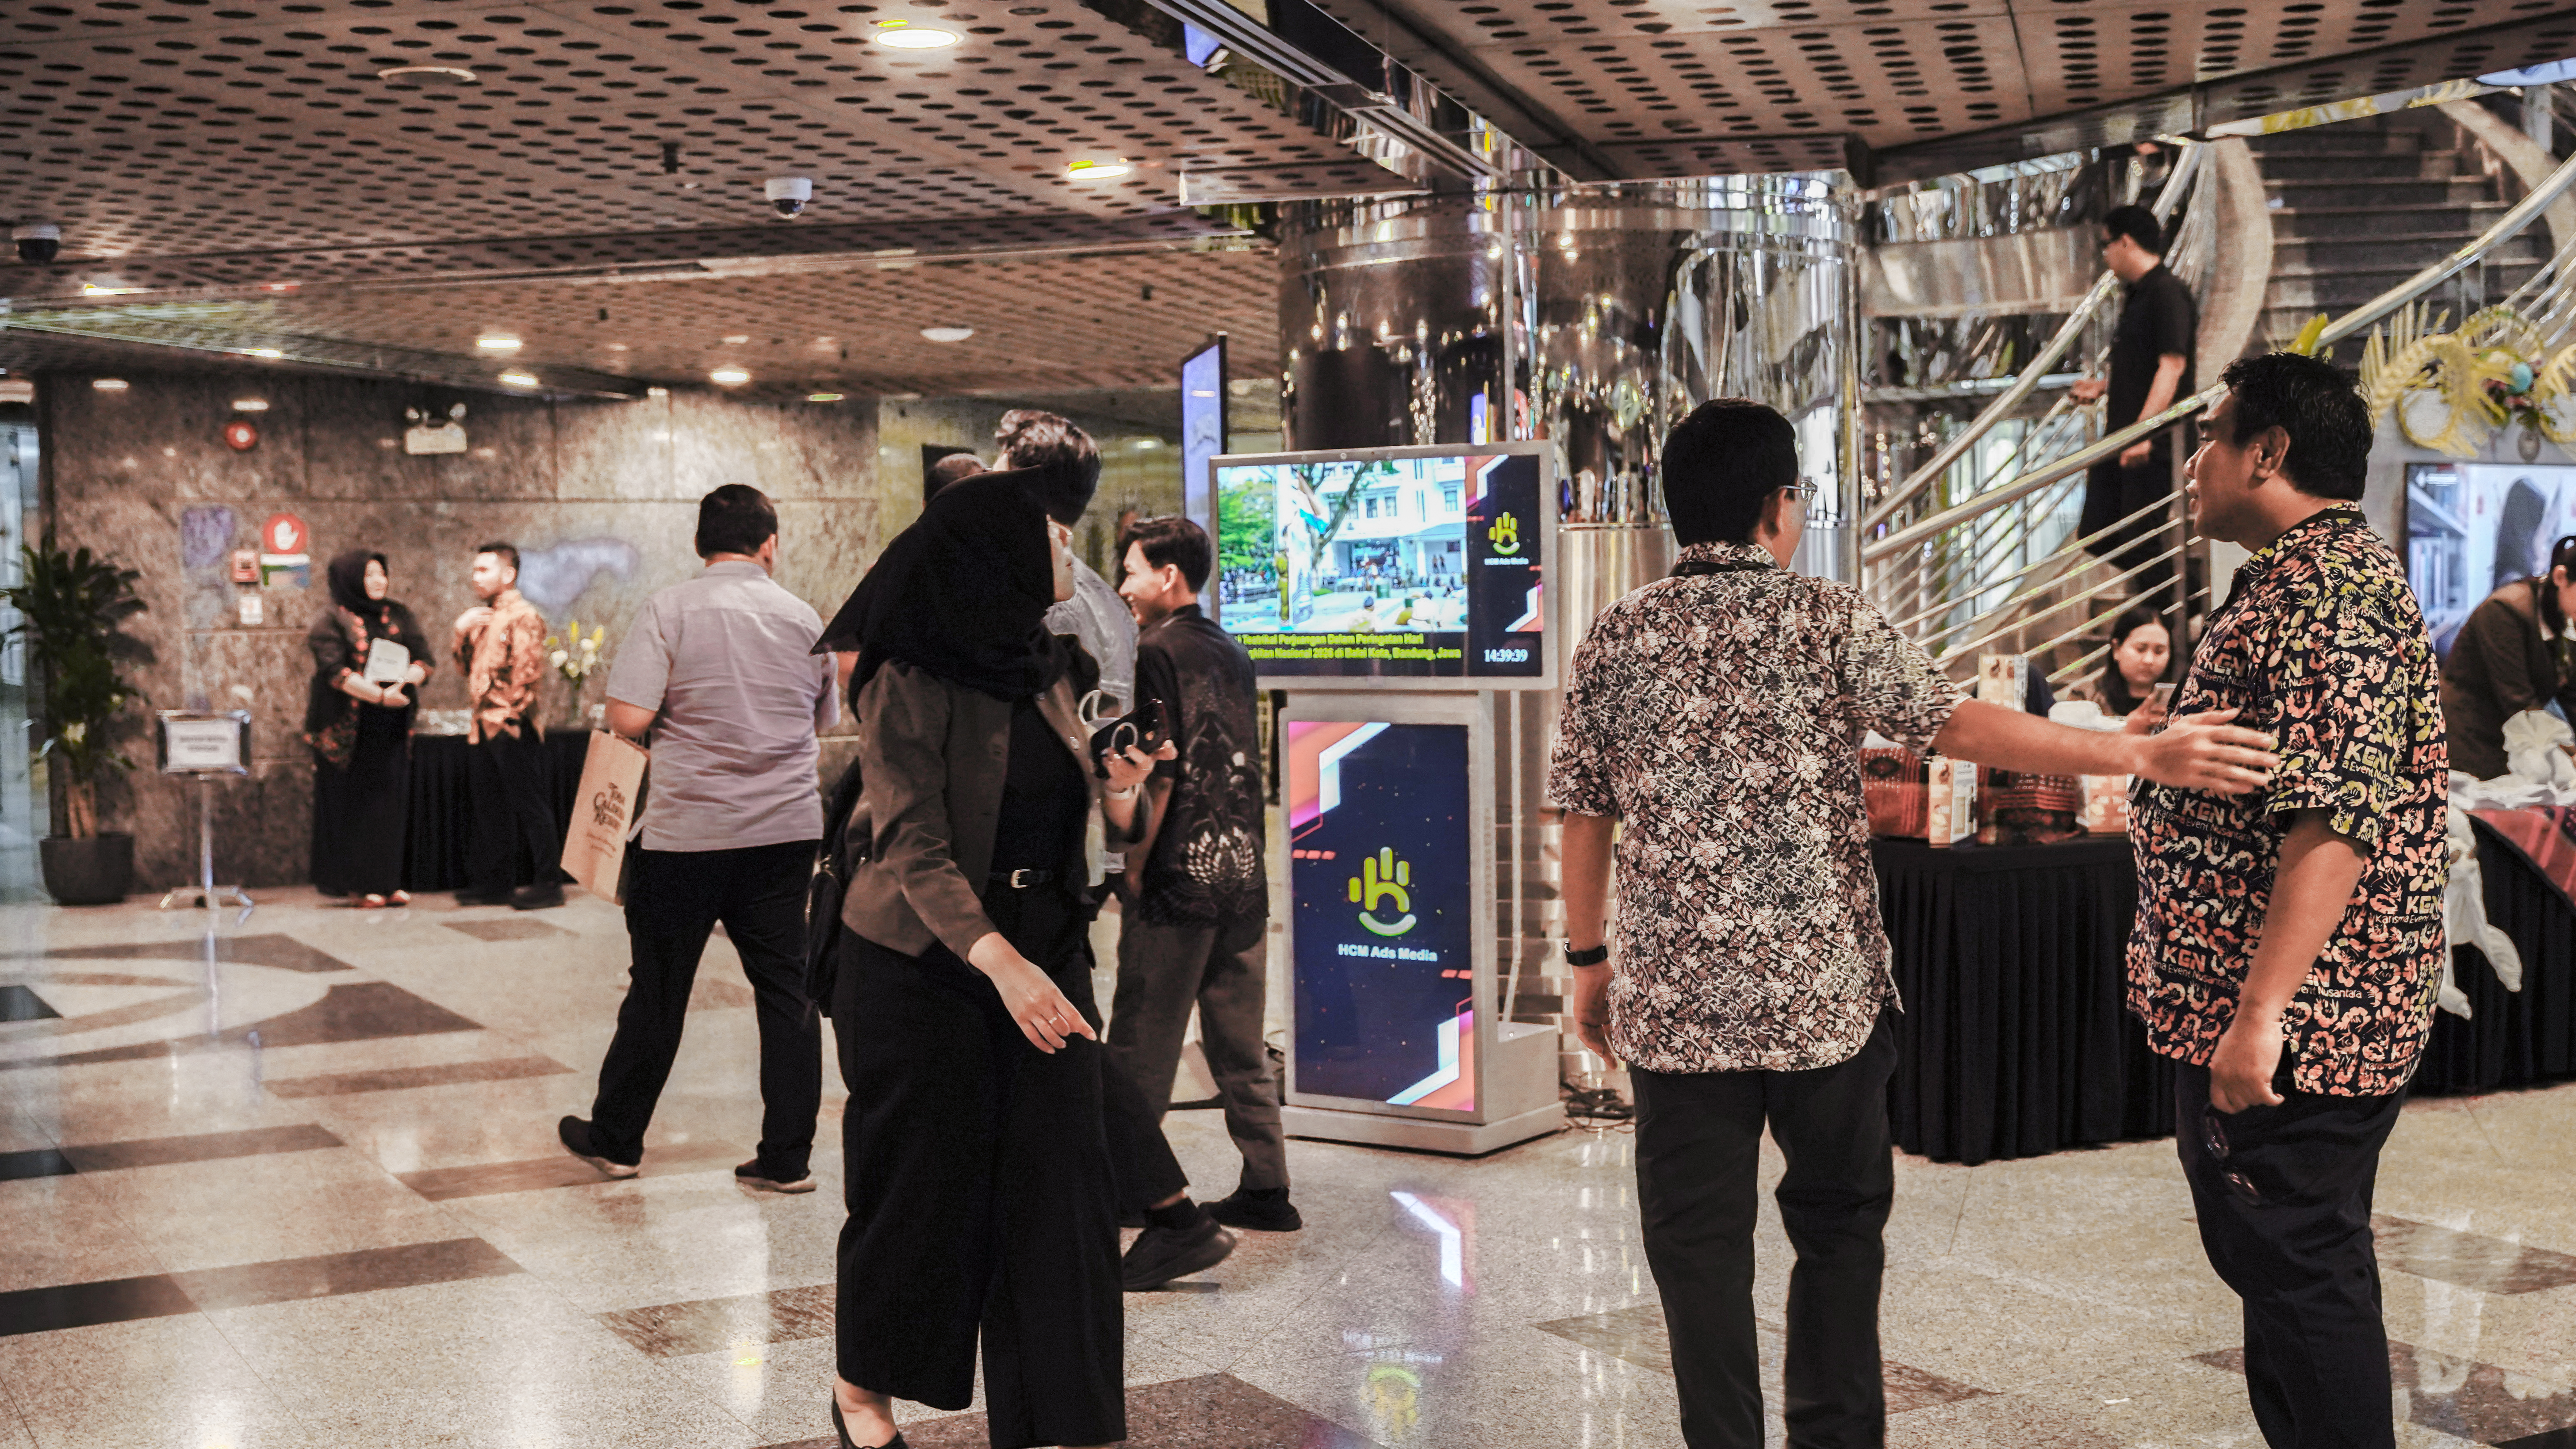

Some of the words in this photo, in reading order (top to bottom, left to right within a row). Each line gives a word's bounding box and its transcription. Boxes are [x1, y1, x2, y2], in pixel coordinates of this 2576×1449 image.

[1278, 634, 1326, 647] Perjuangan
[1327, 634, 1355, 645] Dalam
[1356, 634, 1403, 646] Peringatan
[1404, 633, 1424, 644] Hari
[1275, 647, 1312, 658] Nasional
[1334, 647, 1344, 658] di
[1344, 647, 1367, 658] Balai
[1392, 647, 1436, 661] Bandung,
[1436, 647, 1461, 658] Jawa
[1484, 649, 1528, 662] 14:39:39
[2344, 741, 2388, 772] KEN
[2412, 740, 2447, 765] KEN
[2181, 798, 2225, 826] KEN
[2375, 914, 2409, 924] Karisma
[1338, 943, 1369, 957] HCM
[1370, 945, 1396, 959] Ads
[1398, 947, 1438, 962] Media
[2162, 945, 2206, 972] KEN
[2318, 986, 2362, 999] Nusantara
